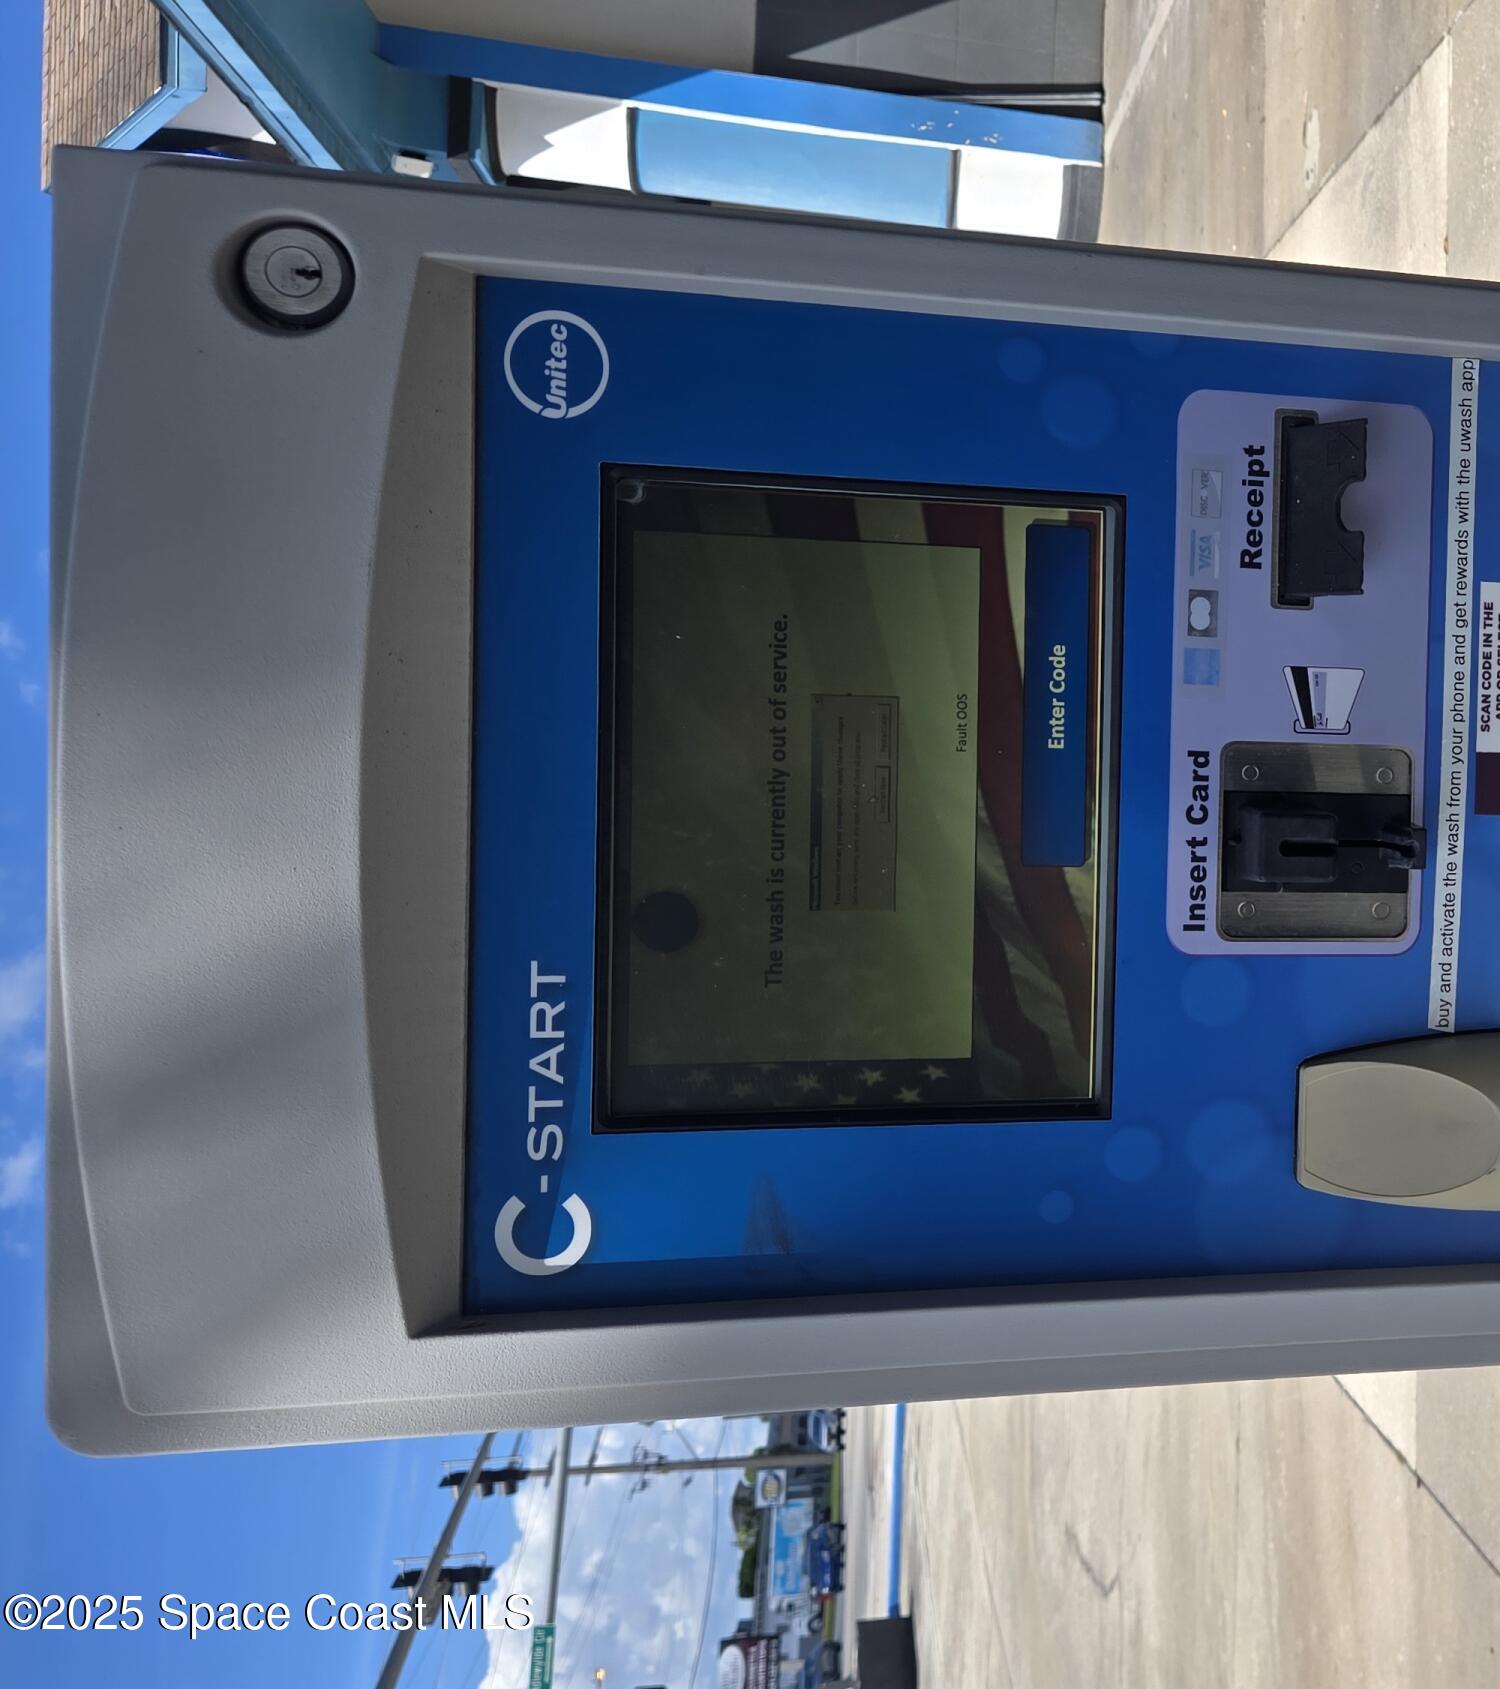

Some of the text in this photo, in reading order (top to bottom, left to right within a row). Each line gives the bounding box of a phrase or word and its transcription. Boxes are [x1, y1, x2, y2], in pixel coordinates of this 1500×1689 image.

[539, 323, 568, 419] Unitec
[1198, 535, 1212, 570] VISA
[1240, 444, 1270, 570] Receipt
[956, 694, 968, 752] Fault OOS
[1048, 644, 1066, 749] Enter Code
[1435, 360, 1476, 1028] buy and activate the wash from your phone and get rewards with the uwash app
[1480, 602, 1494, 732] SCAN CODE IN THE
[764, 614, 790, 988] The wash is currently out of service.
[1182, 750, 1210, 932] Insert Card
